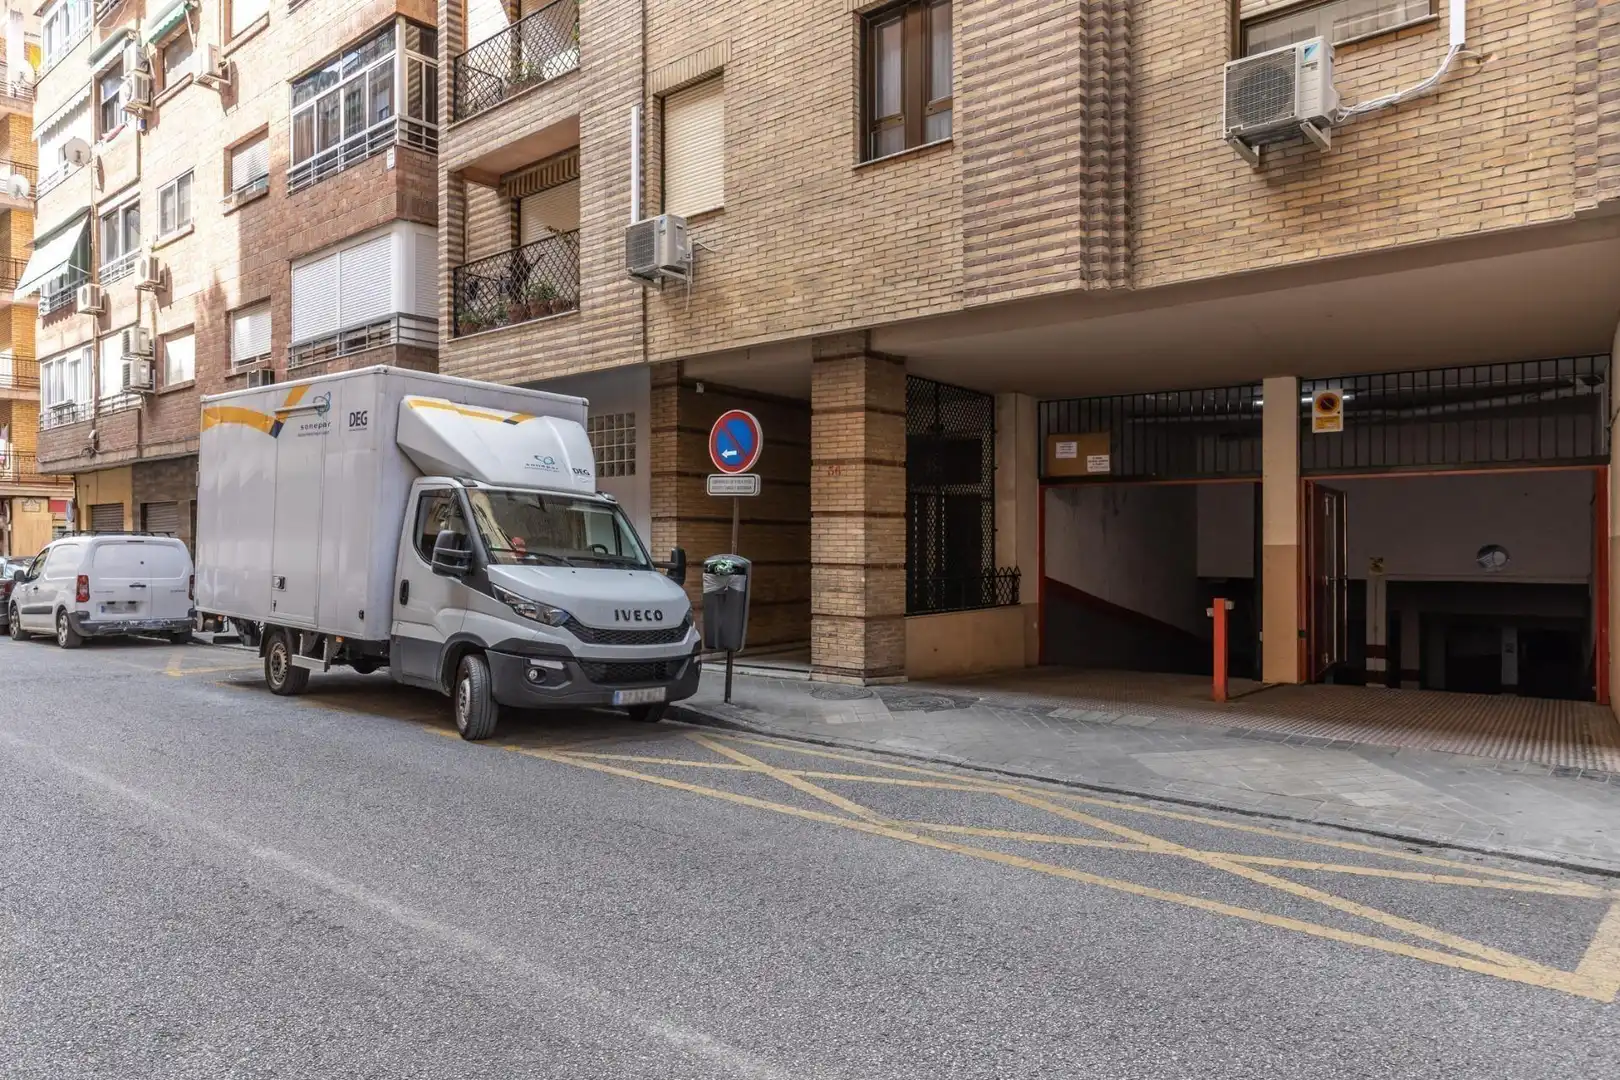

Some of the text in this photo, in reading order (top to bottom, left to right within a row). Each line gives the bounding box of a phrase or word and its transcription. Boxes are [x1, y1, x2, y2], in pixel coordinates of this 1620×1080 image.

[349, 410, 368, 427] DEG
[300, 421, 331, 430] sonepar
[572, 467, 591, 476] DEG
[614, 609, 664, 621] IVECO
